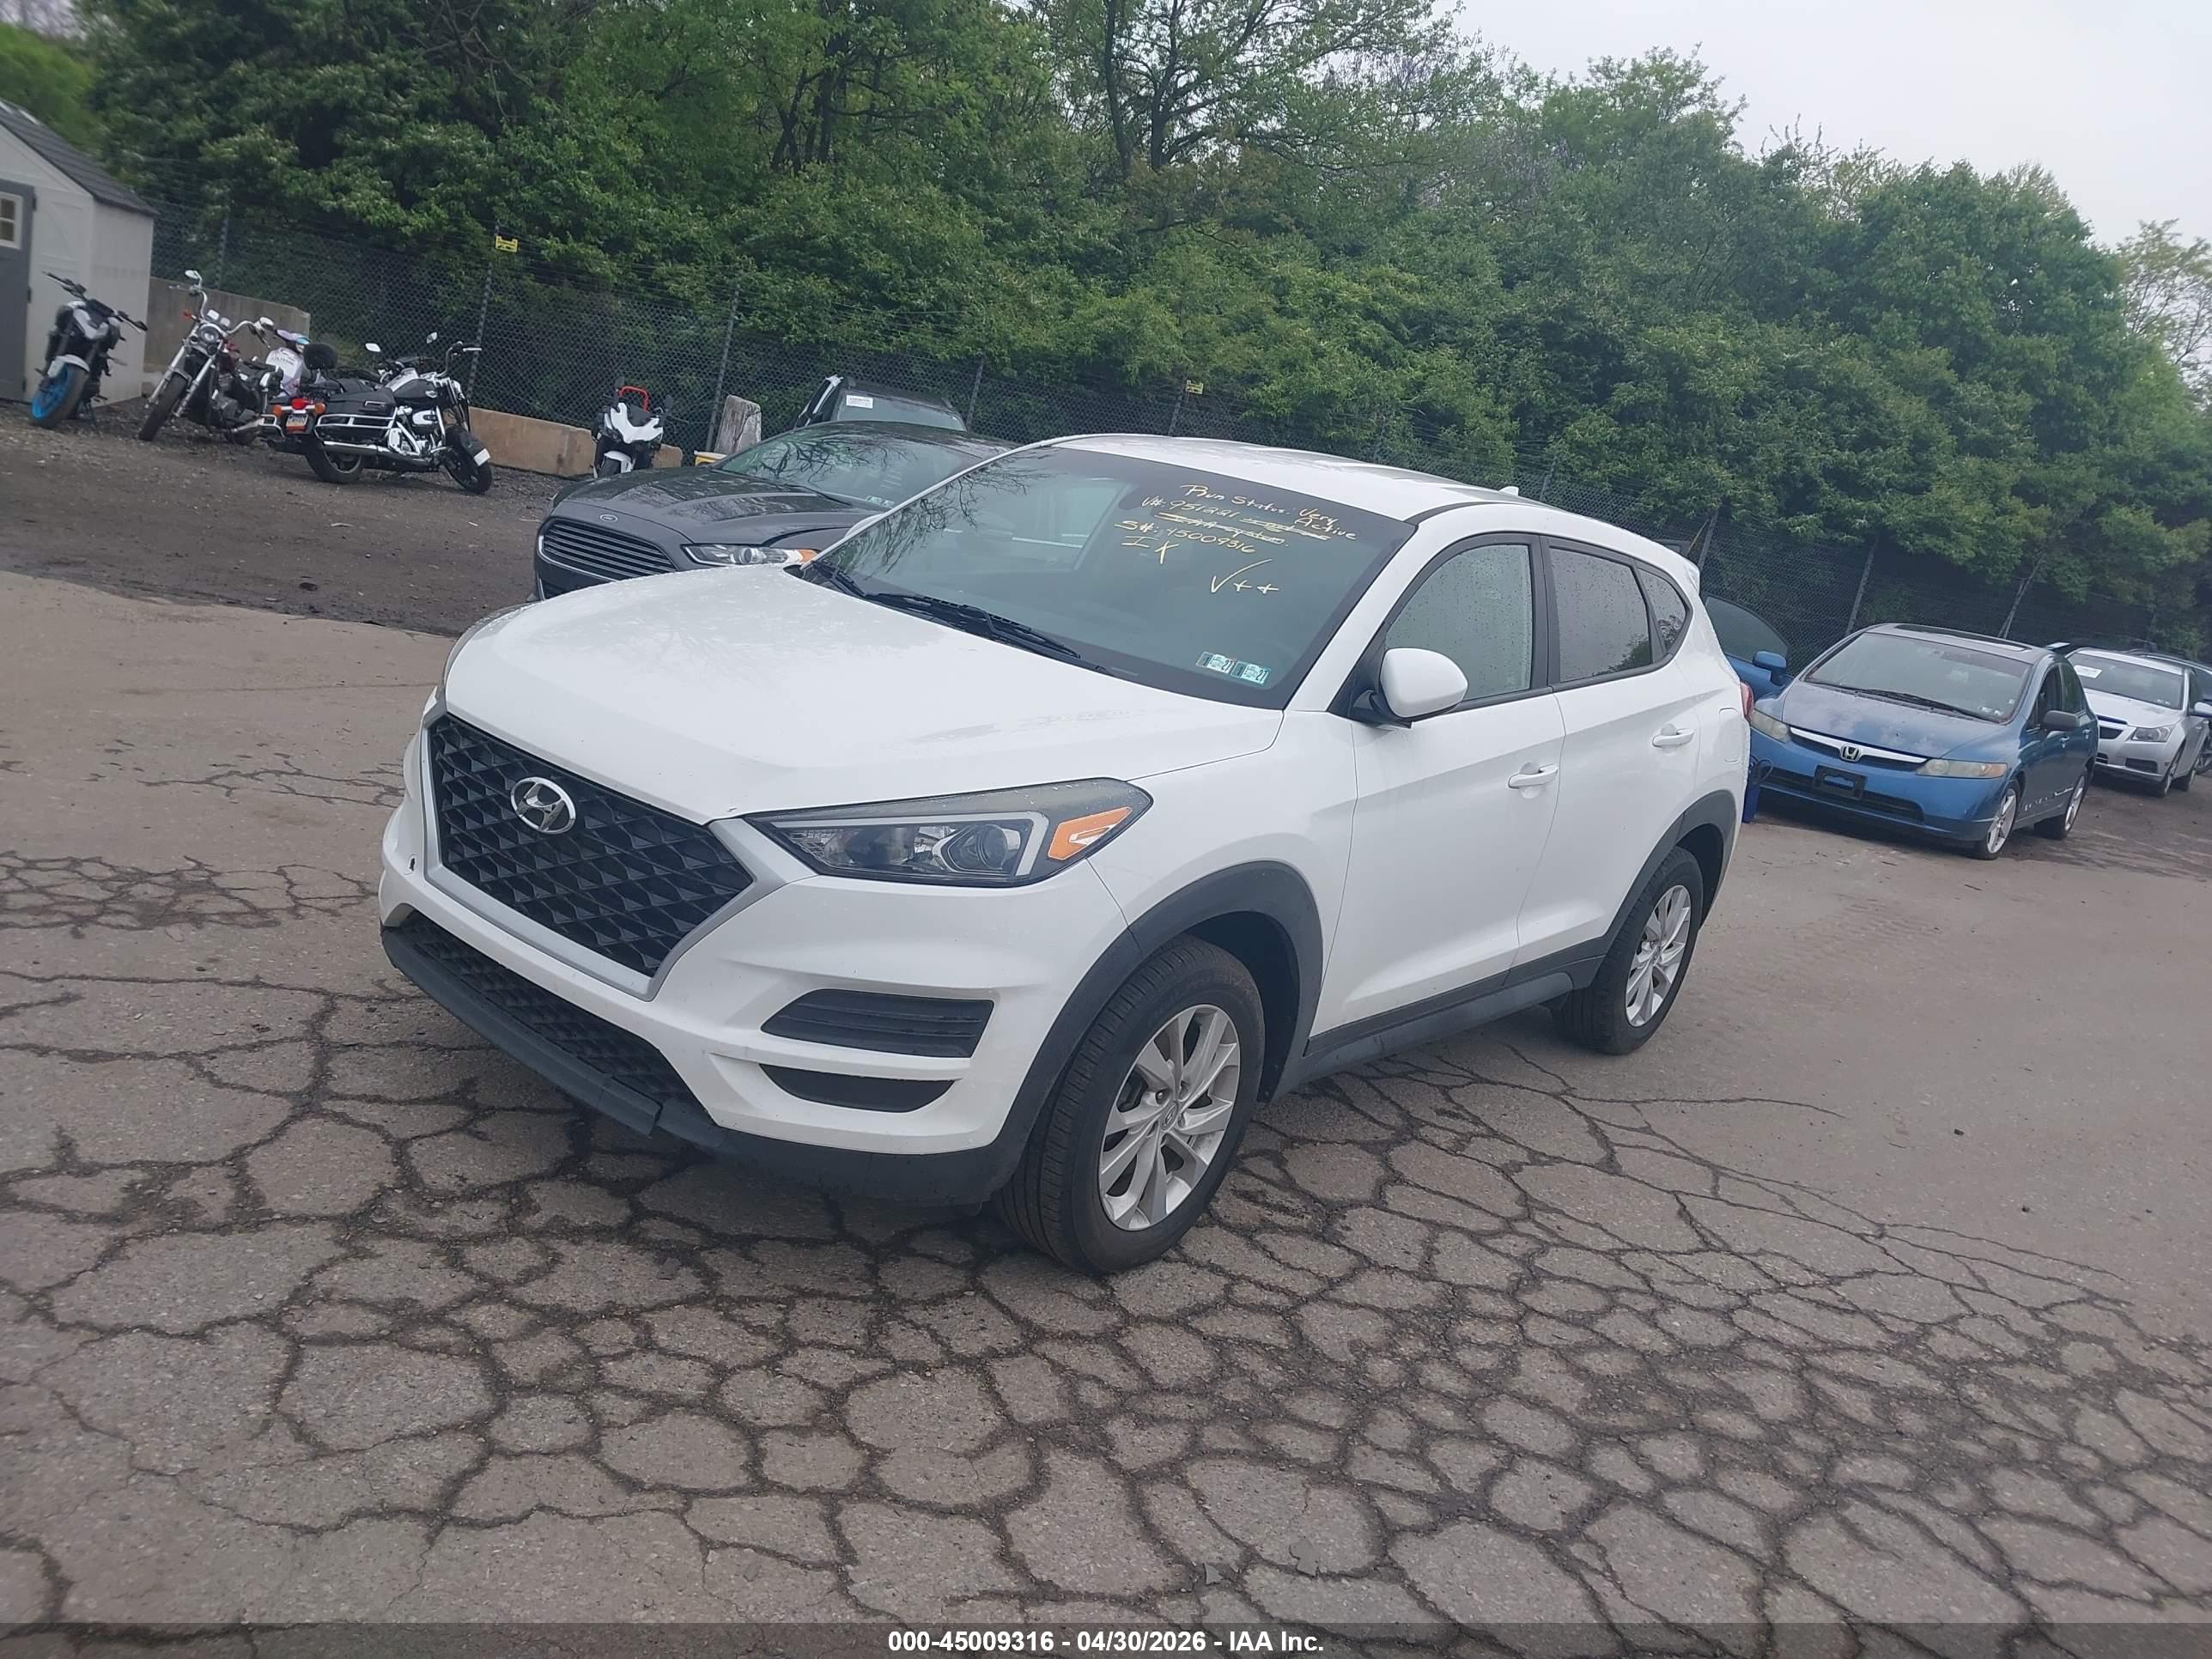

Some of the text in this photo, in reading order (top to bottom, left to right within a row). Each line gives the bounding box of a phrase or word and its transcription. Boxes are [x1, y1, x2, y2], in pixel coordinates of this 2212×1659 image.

[1298, 507, 1340, 526] Very
[1166, 527, 1256, 554] 45009316
[1294, 517, 1358, 541] Active
